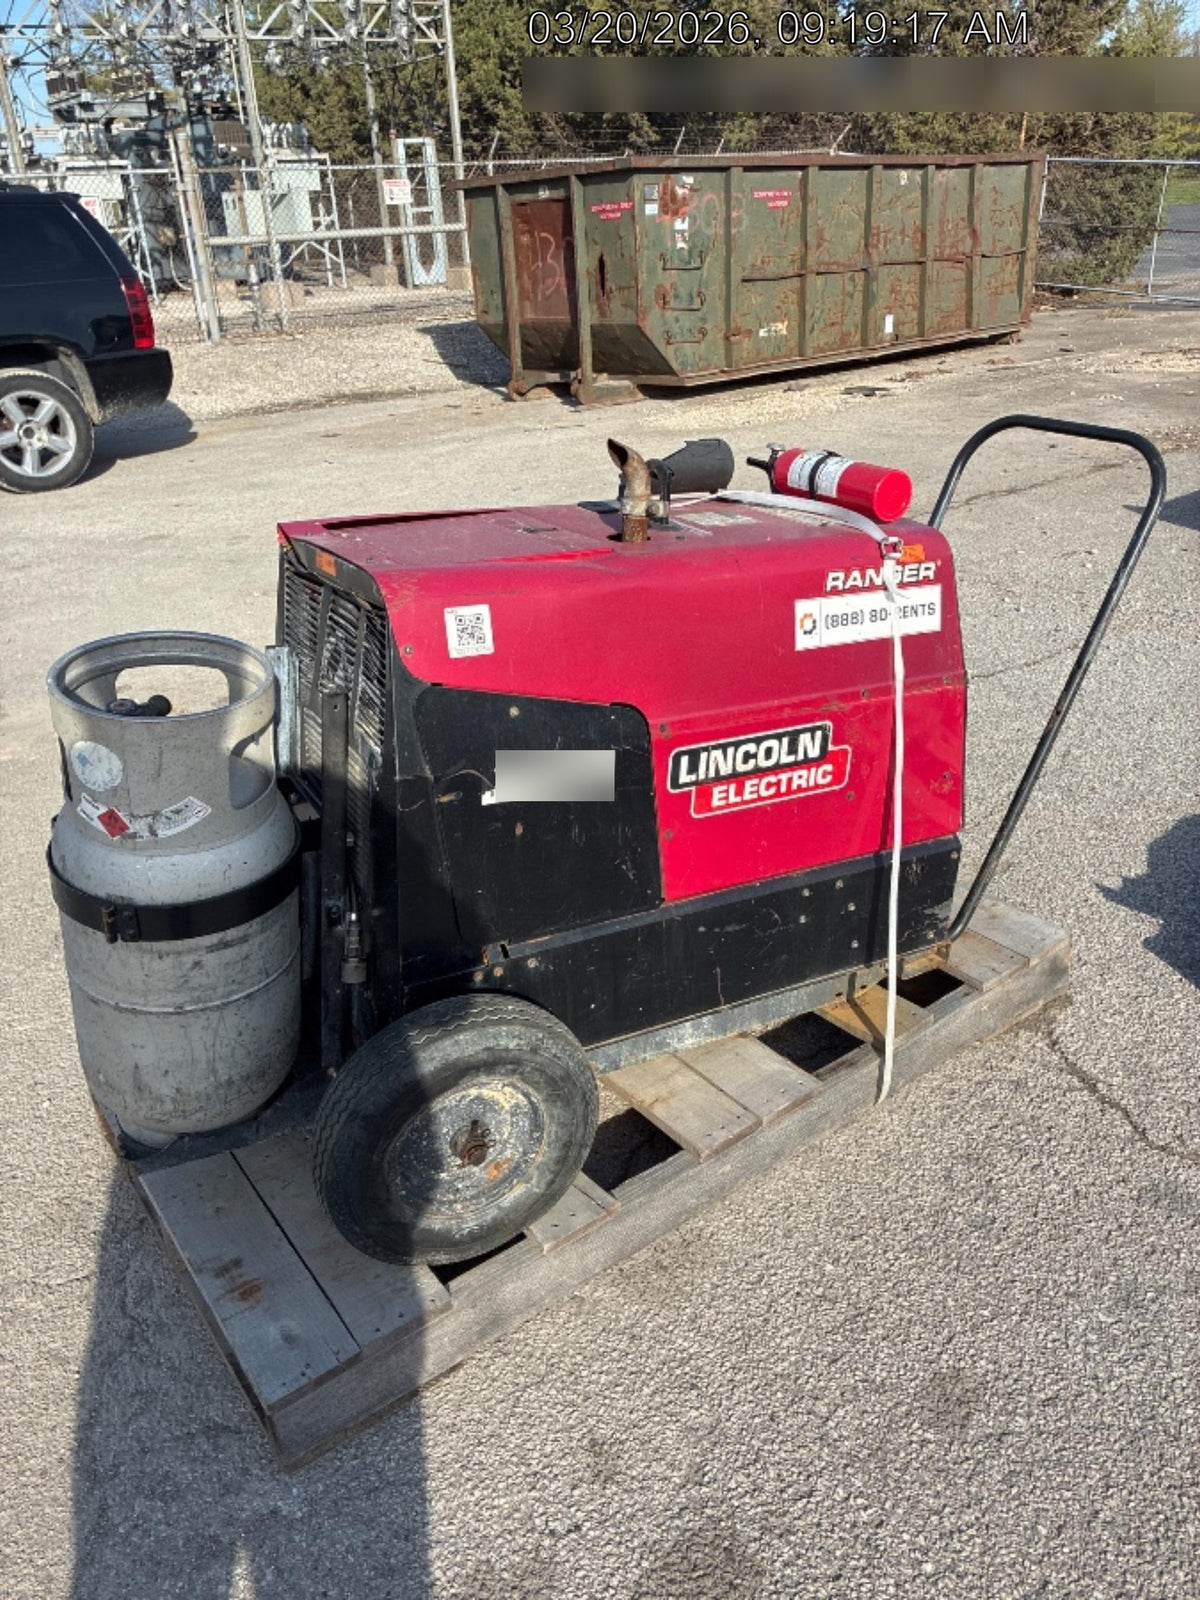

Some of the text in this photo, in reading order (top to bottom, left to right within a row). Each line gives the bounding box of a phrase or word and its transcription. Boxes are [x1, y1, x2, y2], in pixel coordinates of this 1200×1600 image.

[824, 608, 865, 630] (888)
[678, 730, 823, 785] LINCOLN
[711, 763, 834, 808] ELECTRIC
